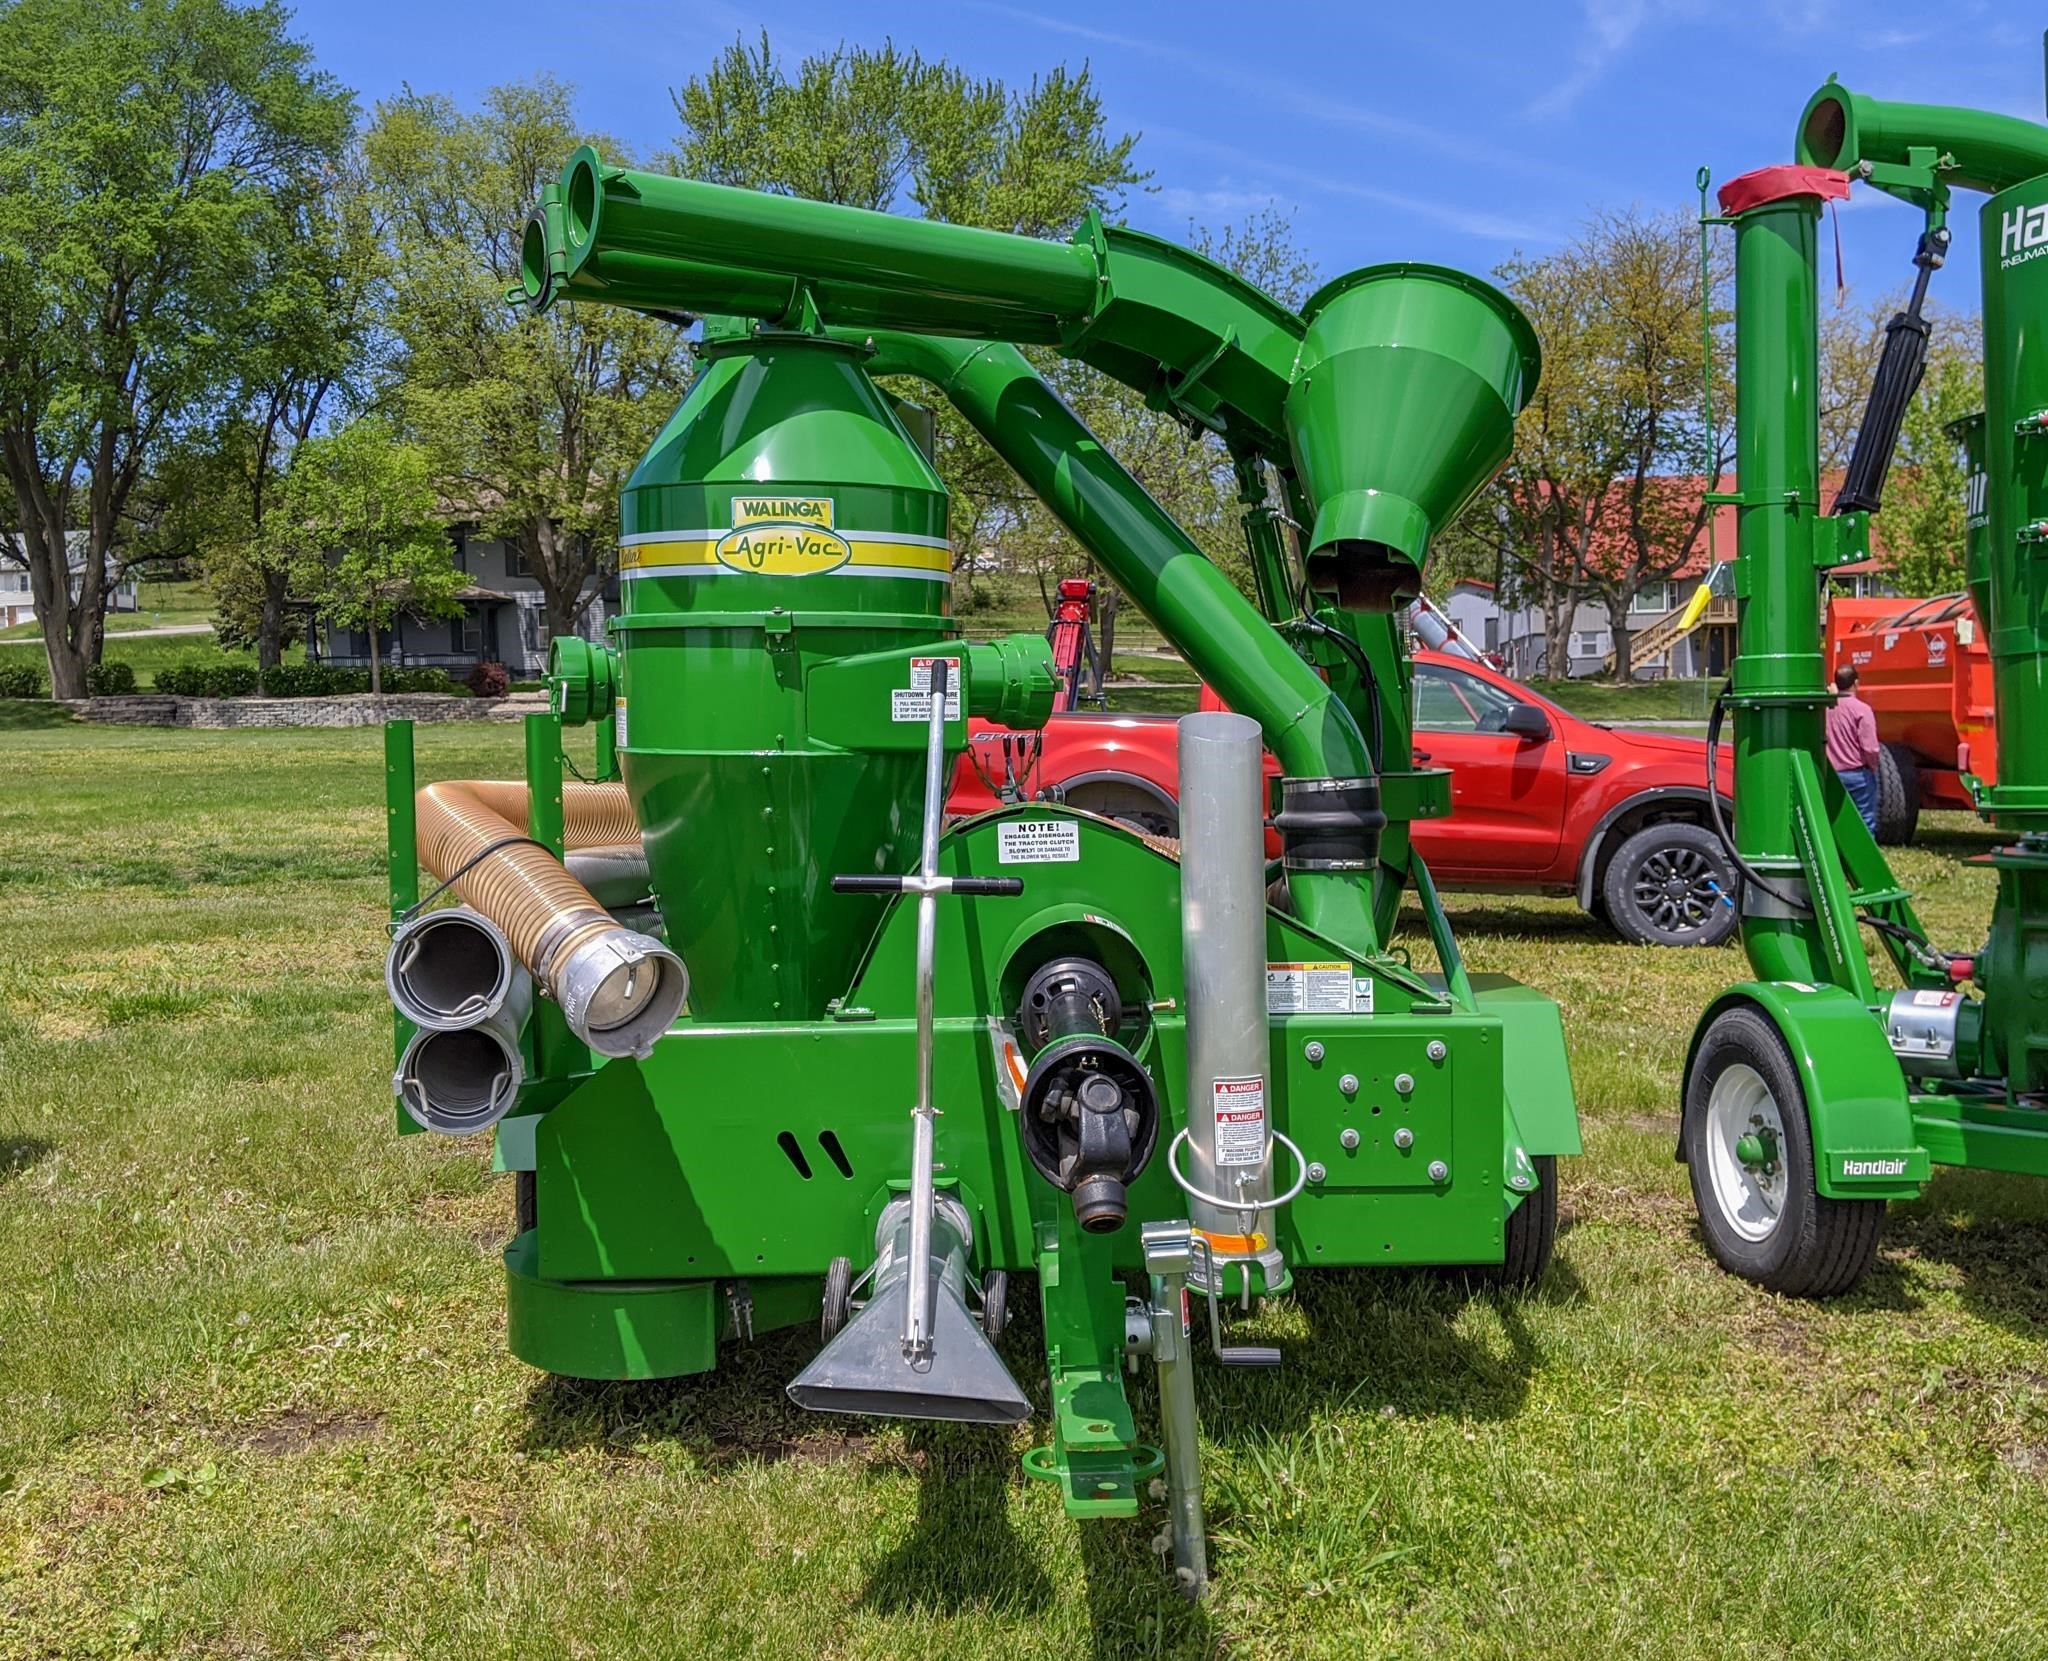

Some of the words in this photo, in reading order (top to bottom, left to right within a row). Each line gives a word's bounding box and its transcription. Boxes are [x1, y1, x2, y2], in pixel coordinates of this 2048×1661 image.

[742, 501, 823, 517] WALINGA
[723, 536, 842, 568] Agri-Vac
[1018, 823, 1060, 832] NOTE!
[1230, 1083, 1260, 1092] DANGER
[1231, 1112, 1260, 1121] DANGER
[1843, 1158, 1907, 1175] Handlair
